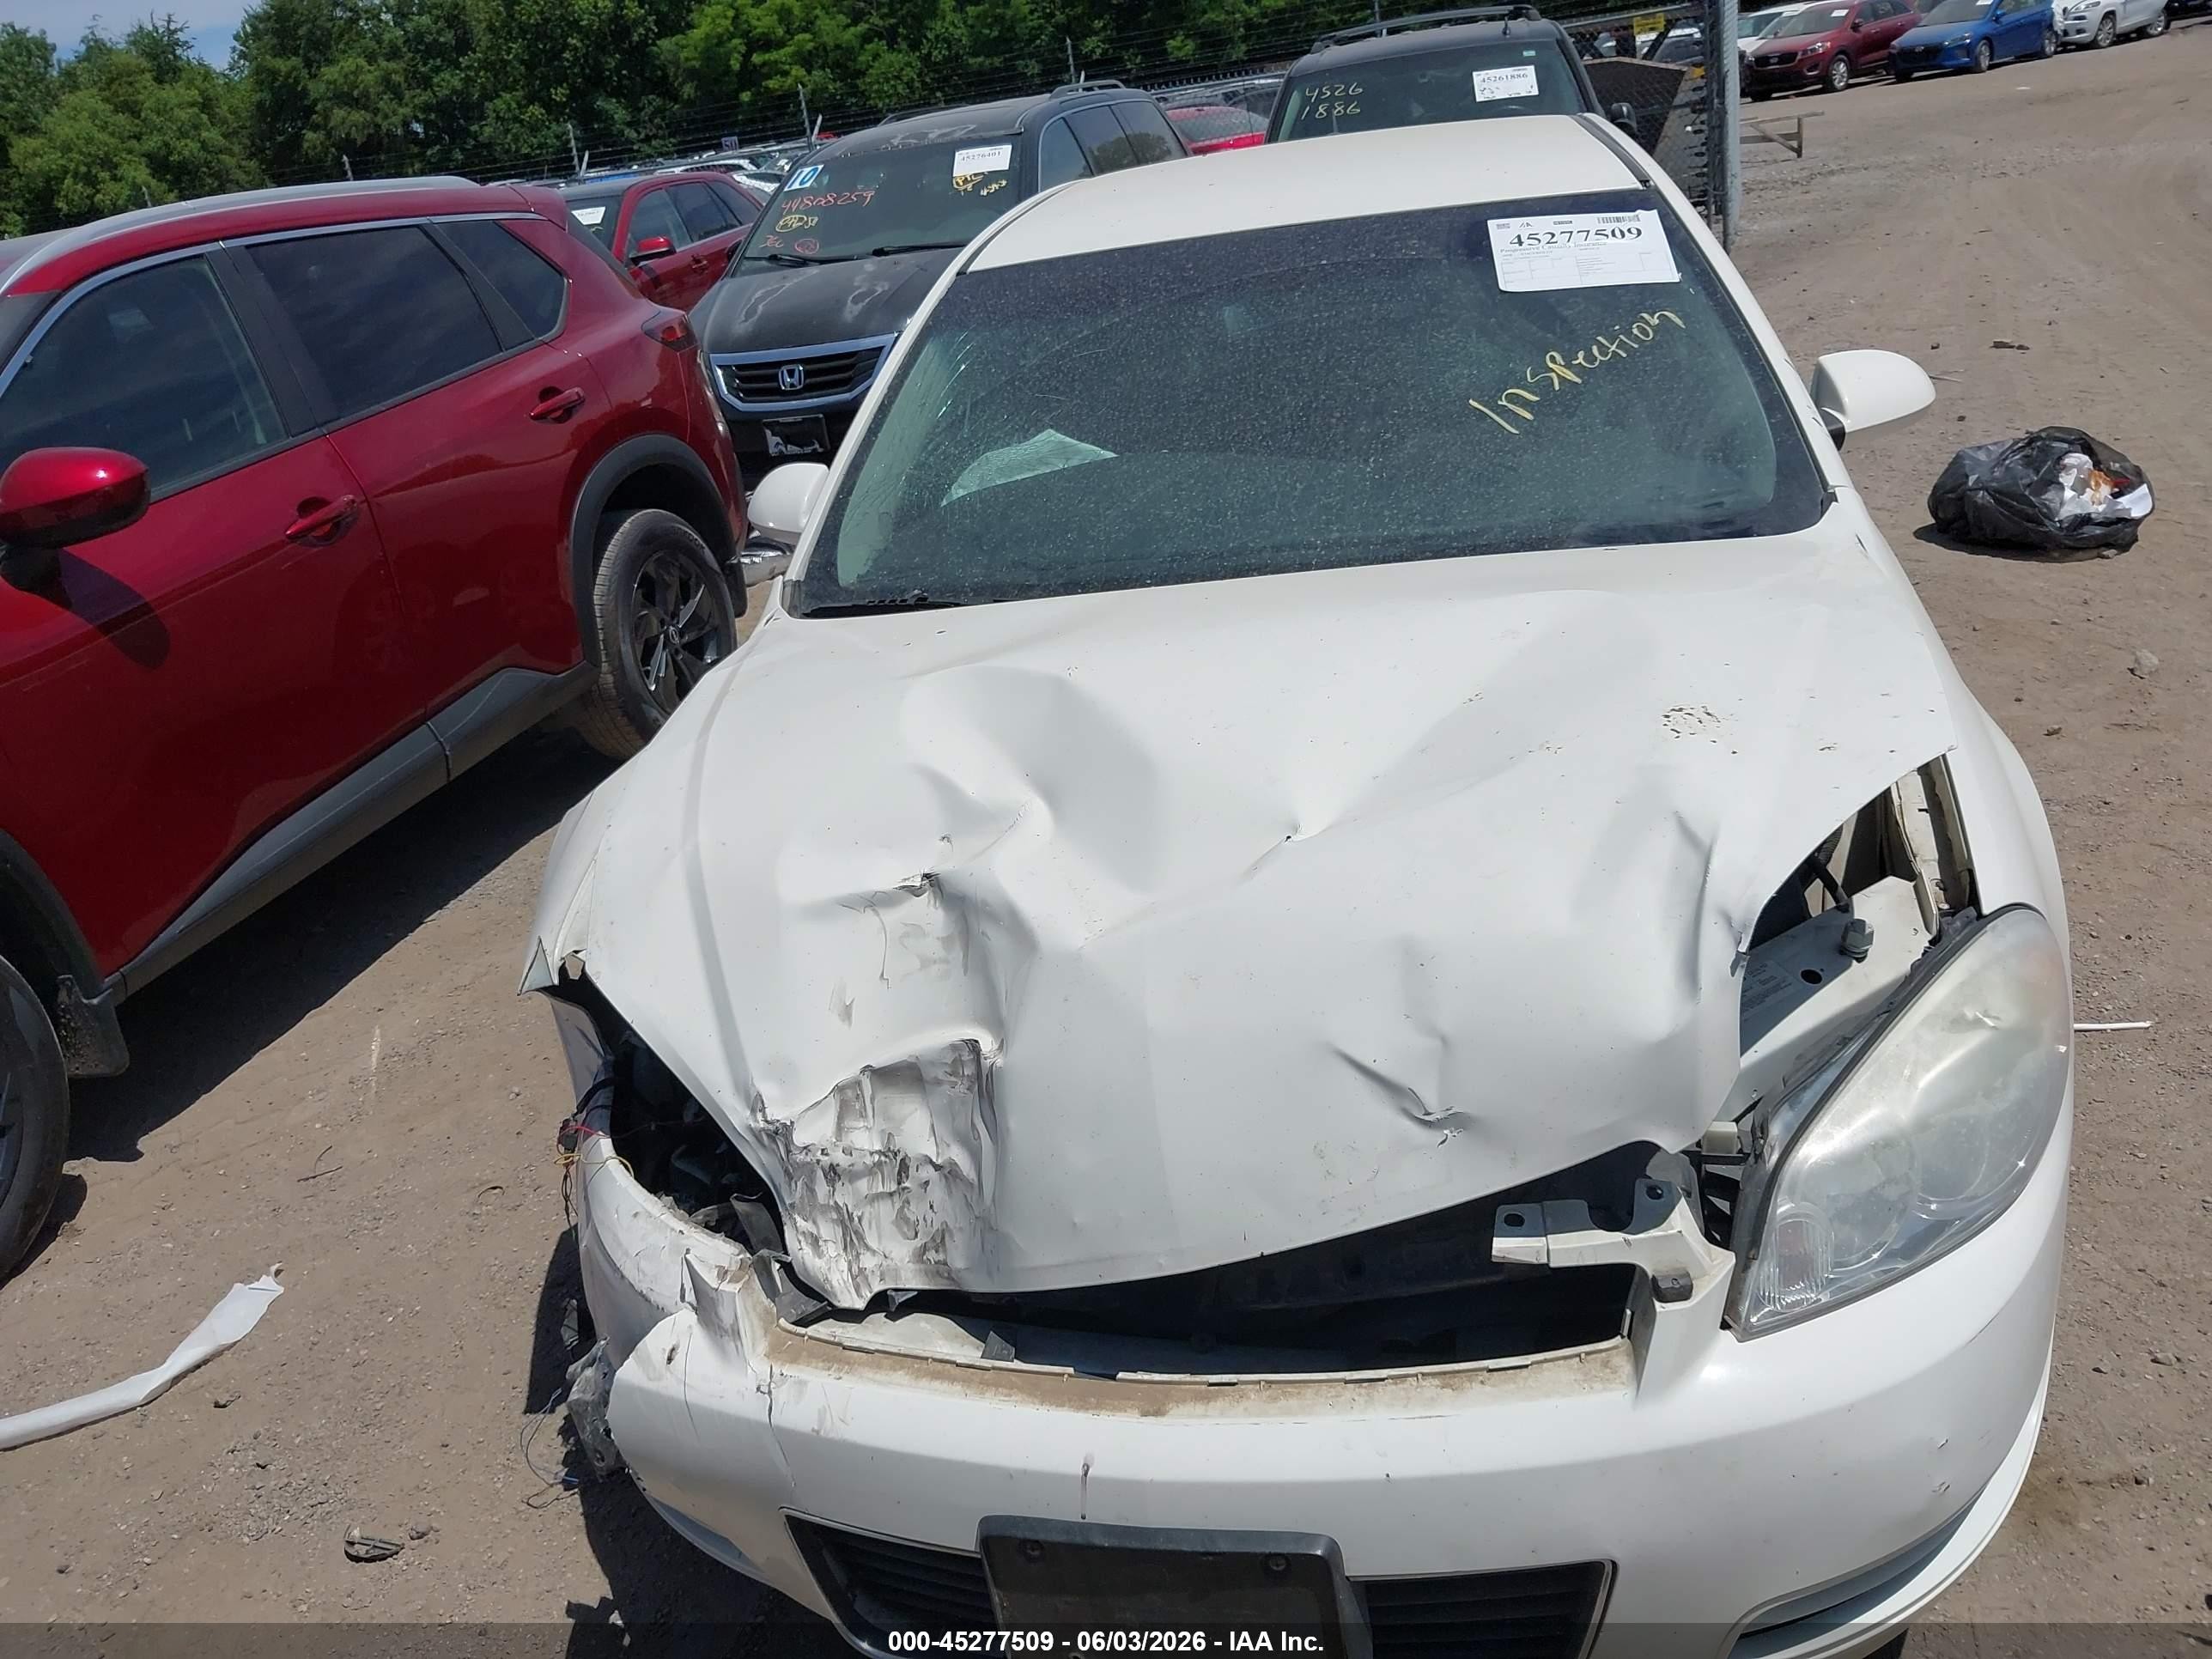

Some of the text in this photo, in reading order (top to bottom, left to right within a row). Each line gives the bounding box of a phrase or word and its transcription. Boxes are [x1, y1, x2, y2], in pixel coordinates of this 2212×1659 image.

[1305, 82, 1364, 103] 4526
[1301, 101, 1361, 120] 1886
[787, 165, 819, 189] 10
[1510, 226, 1643, 247] 45277509
